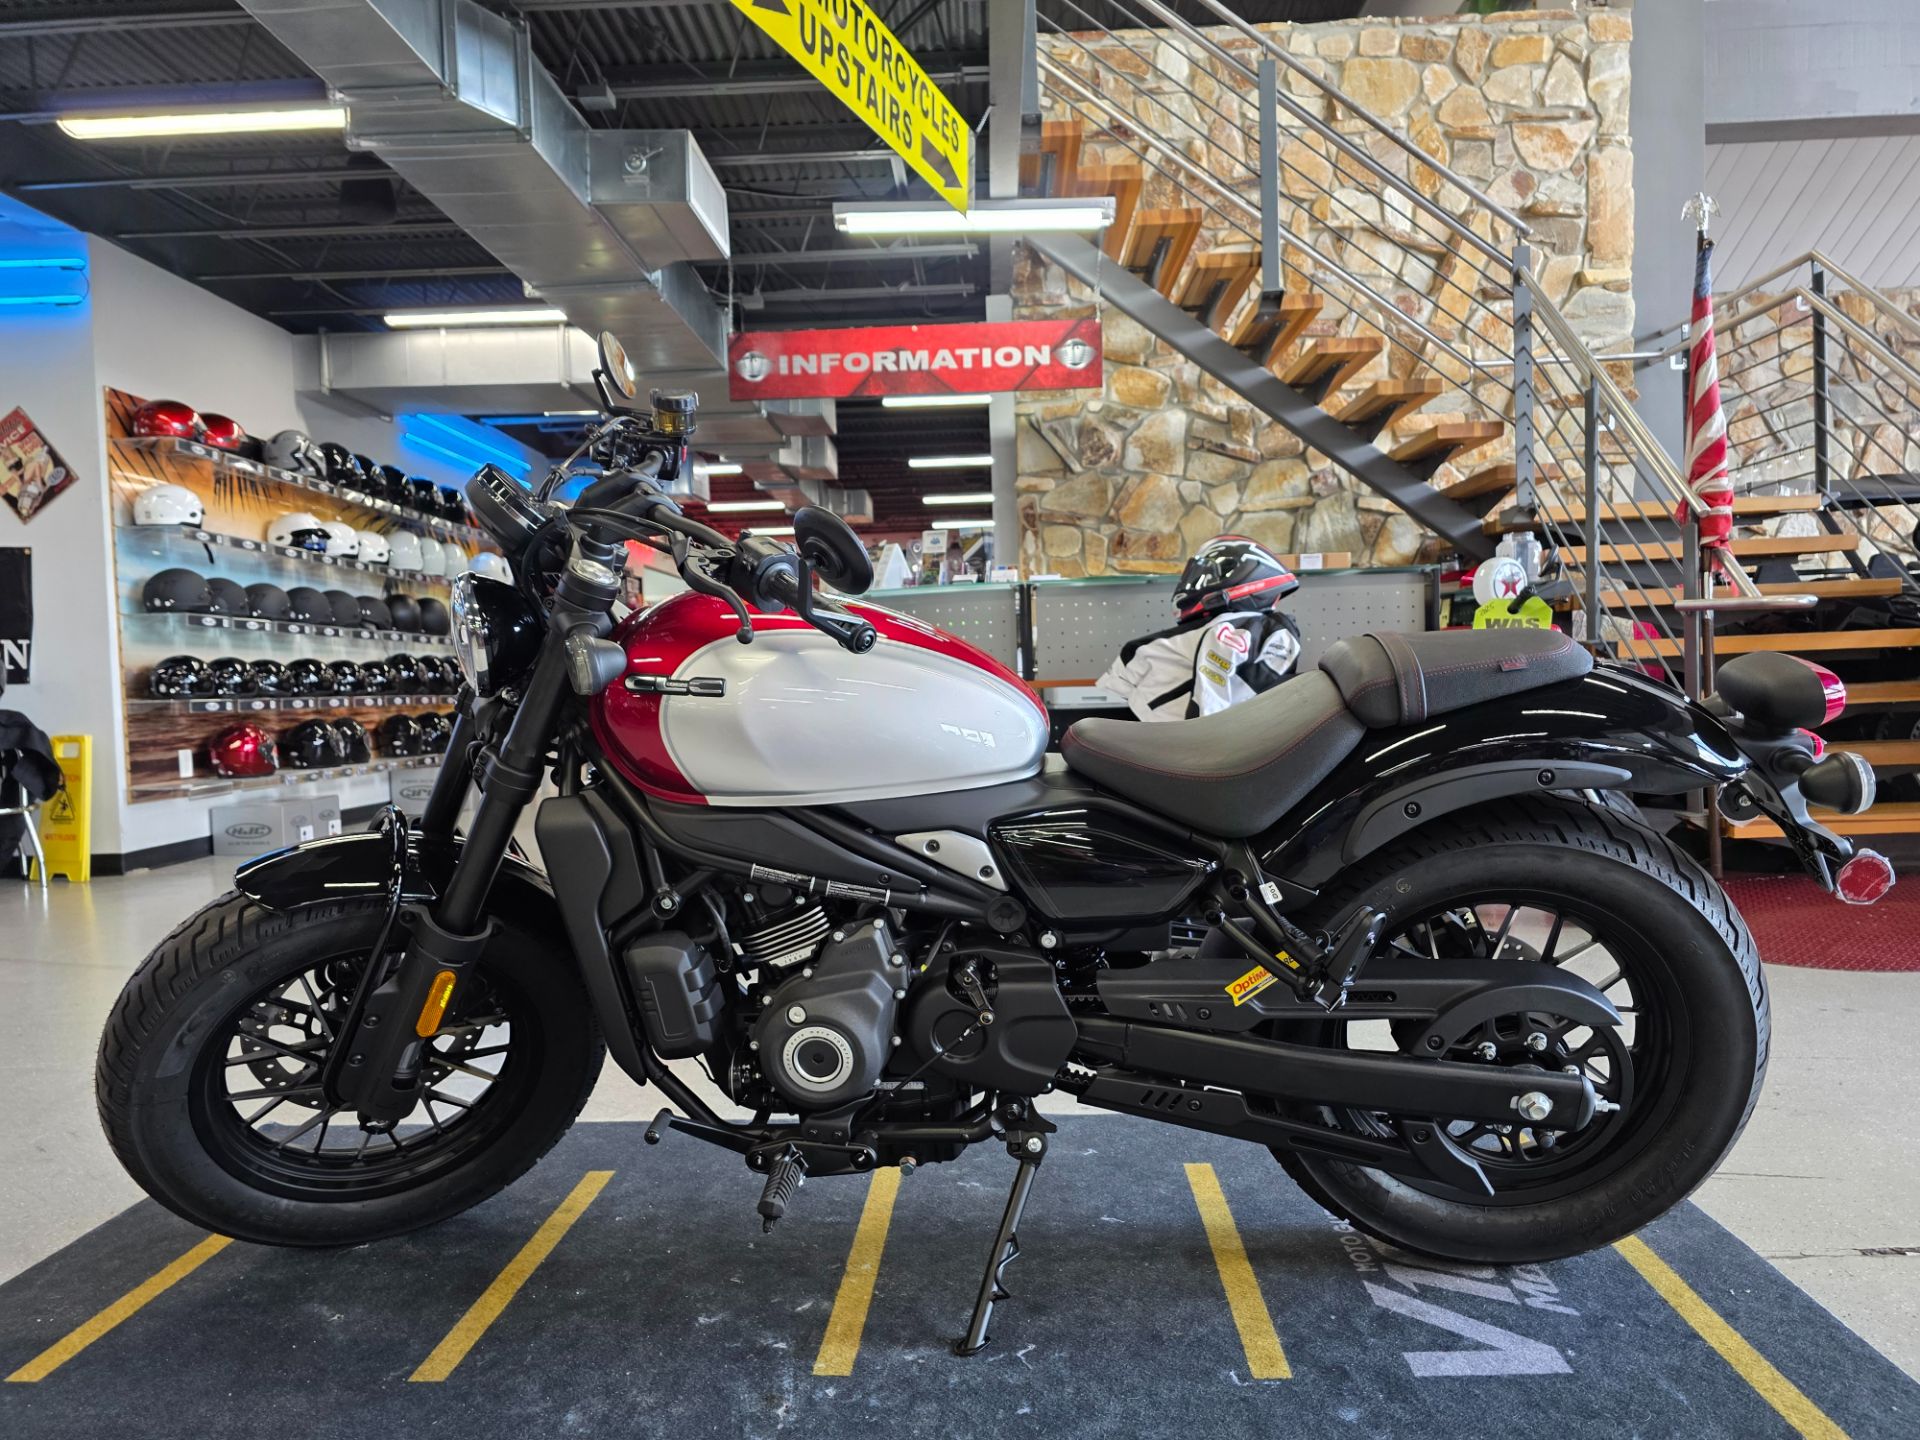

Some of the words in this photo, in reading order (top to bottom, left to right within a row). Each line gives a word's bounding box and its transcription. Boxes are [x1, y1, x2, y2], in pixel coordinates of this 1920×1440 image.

[799, 4, 913, 149] UPSTAIRS
[778, 344, 1051, 376] INFORMATION
[1485, 618, 1540, 629] WAS
[1340, 1235, 1379, 1274] MOTO
